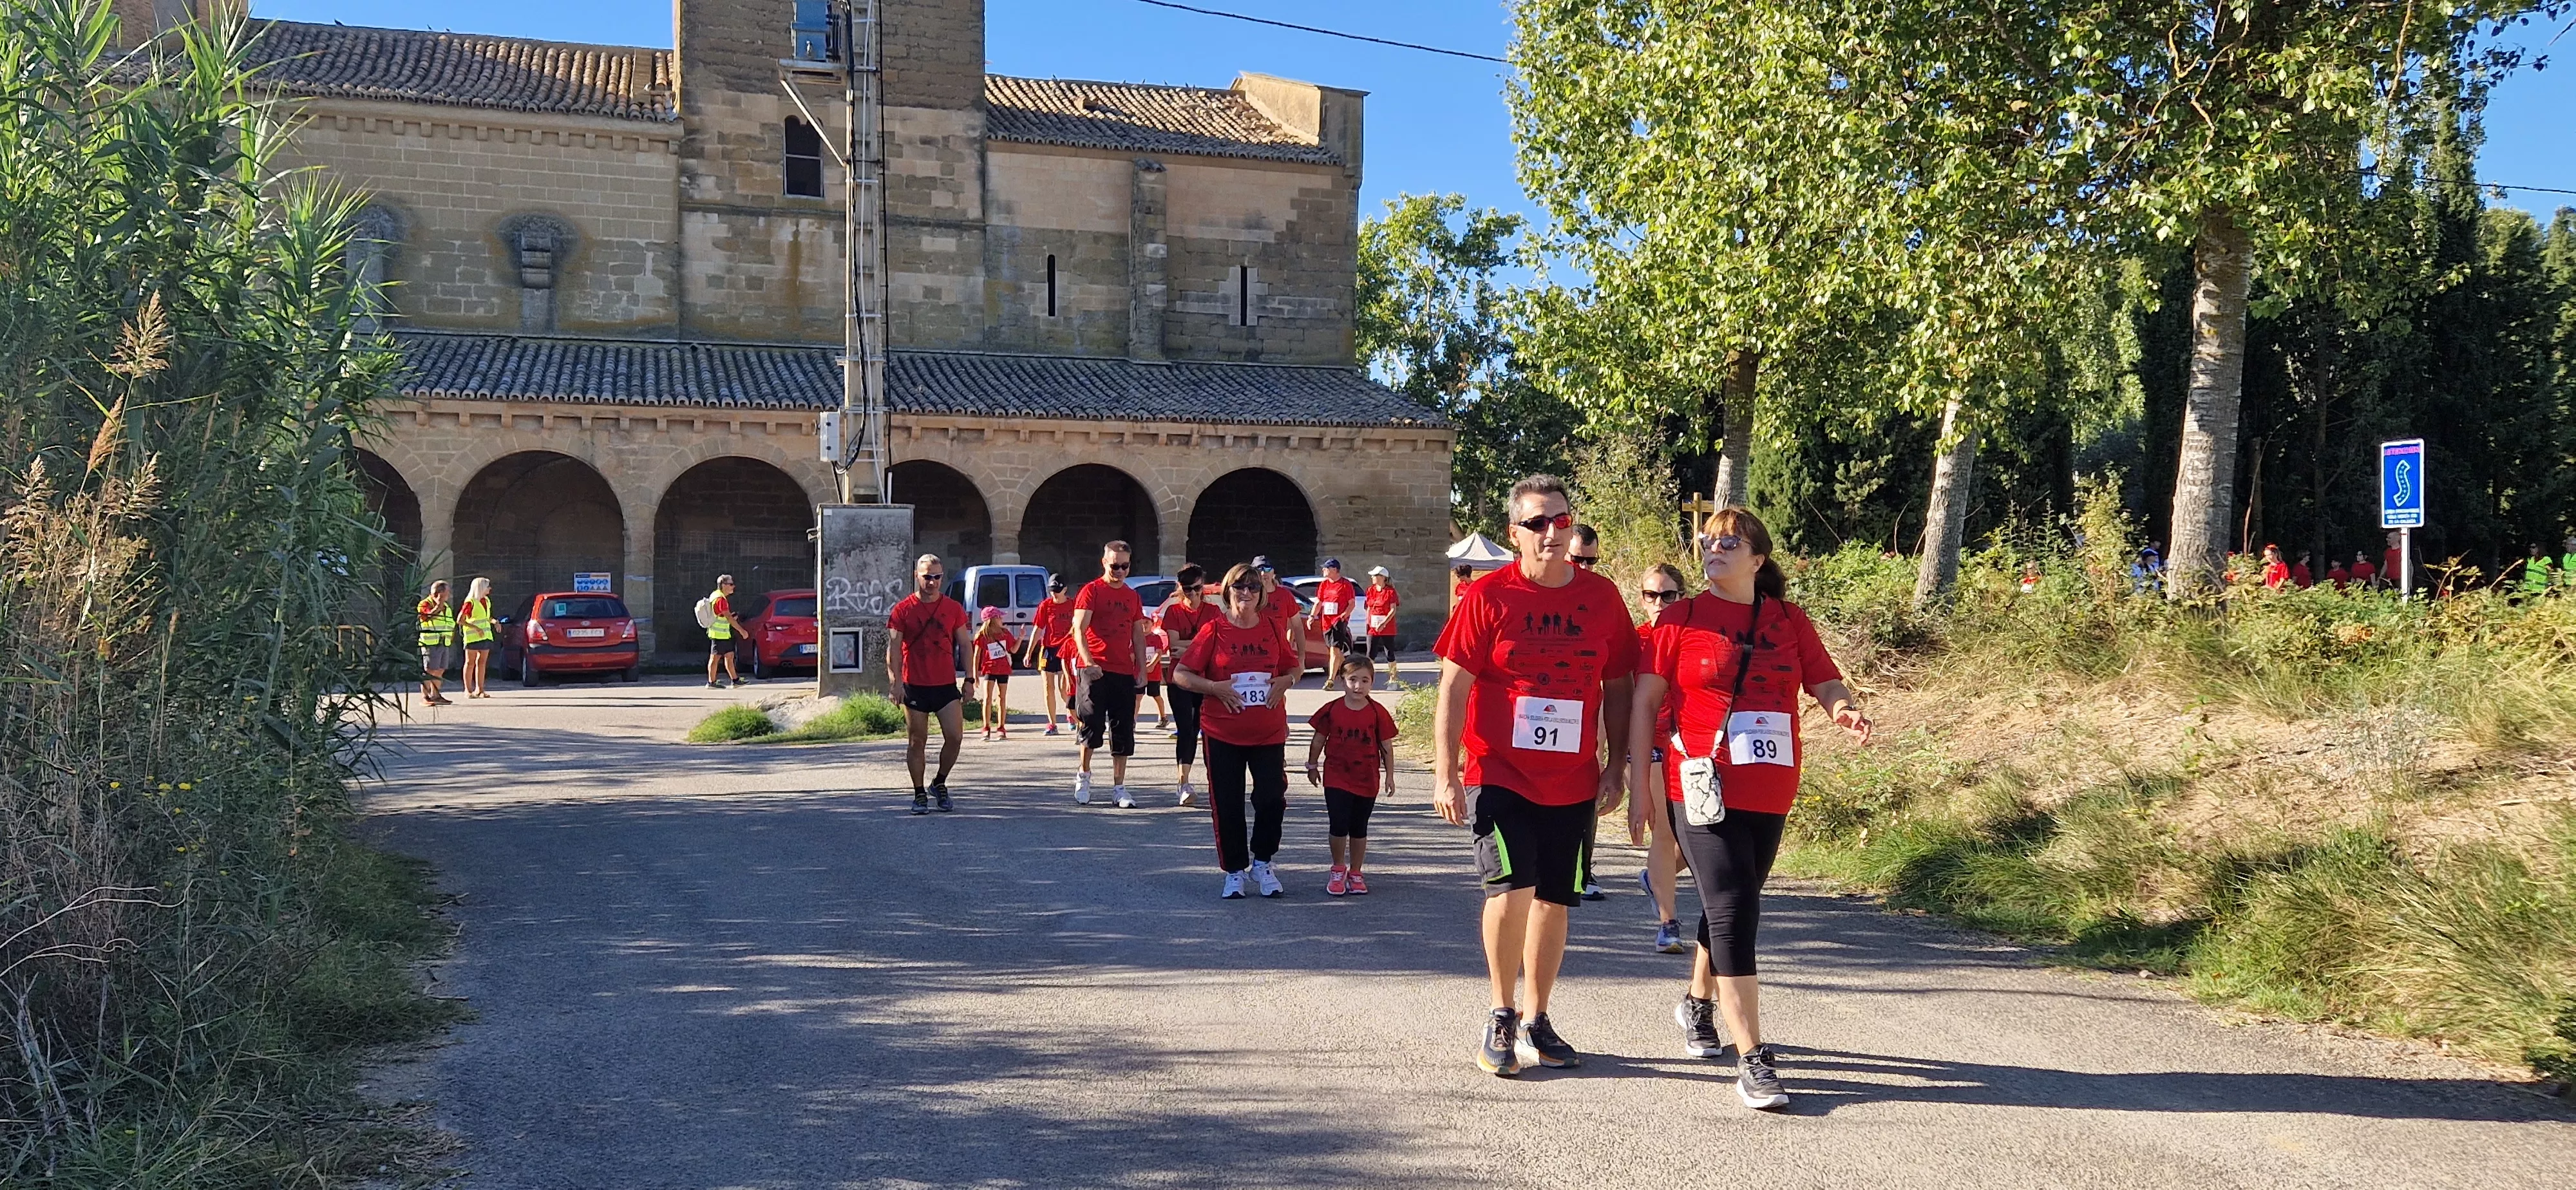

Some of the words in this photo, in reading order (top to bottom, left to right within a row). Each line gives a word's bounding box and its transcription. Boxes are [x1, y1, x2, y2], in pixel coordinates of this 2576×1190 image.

[1241, 690, 1265, 703] 183
[1533, 726, 1558, 746] 91
[1752, 739, 1777, 759] 89
